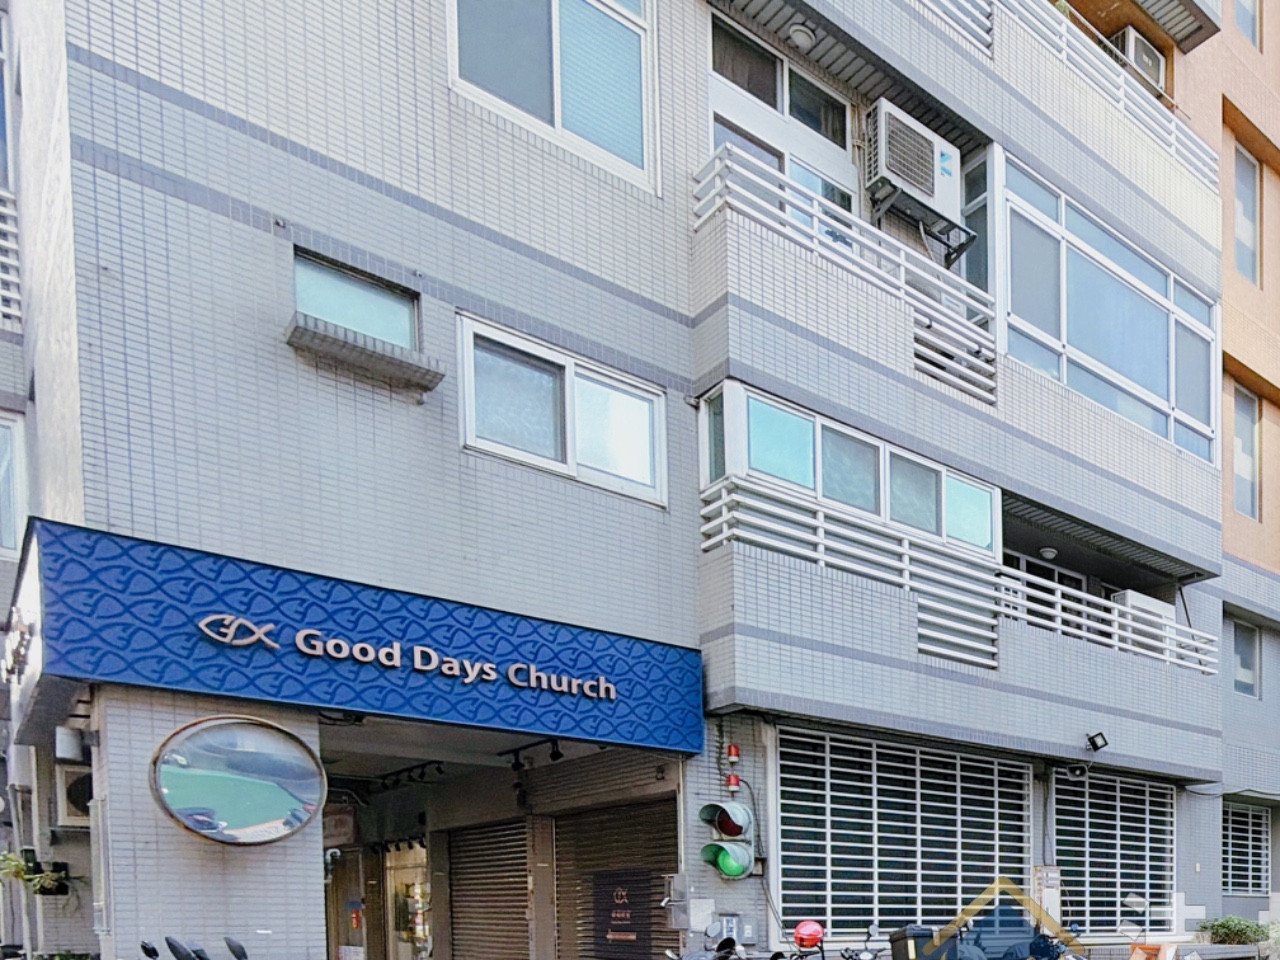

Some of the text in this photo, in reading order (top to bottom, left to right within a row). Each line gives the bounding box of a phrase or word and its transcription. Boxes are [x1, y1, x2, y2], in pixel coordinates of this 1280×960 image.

[295, 628, 618, 700] Good Days Church
